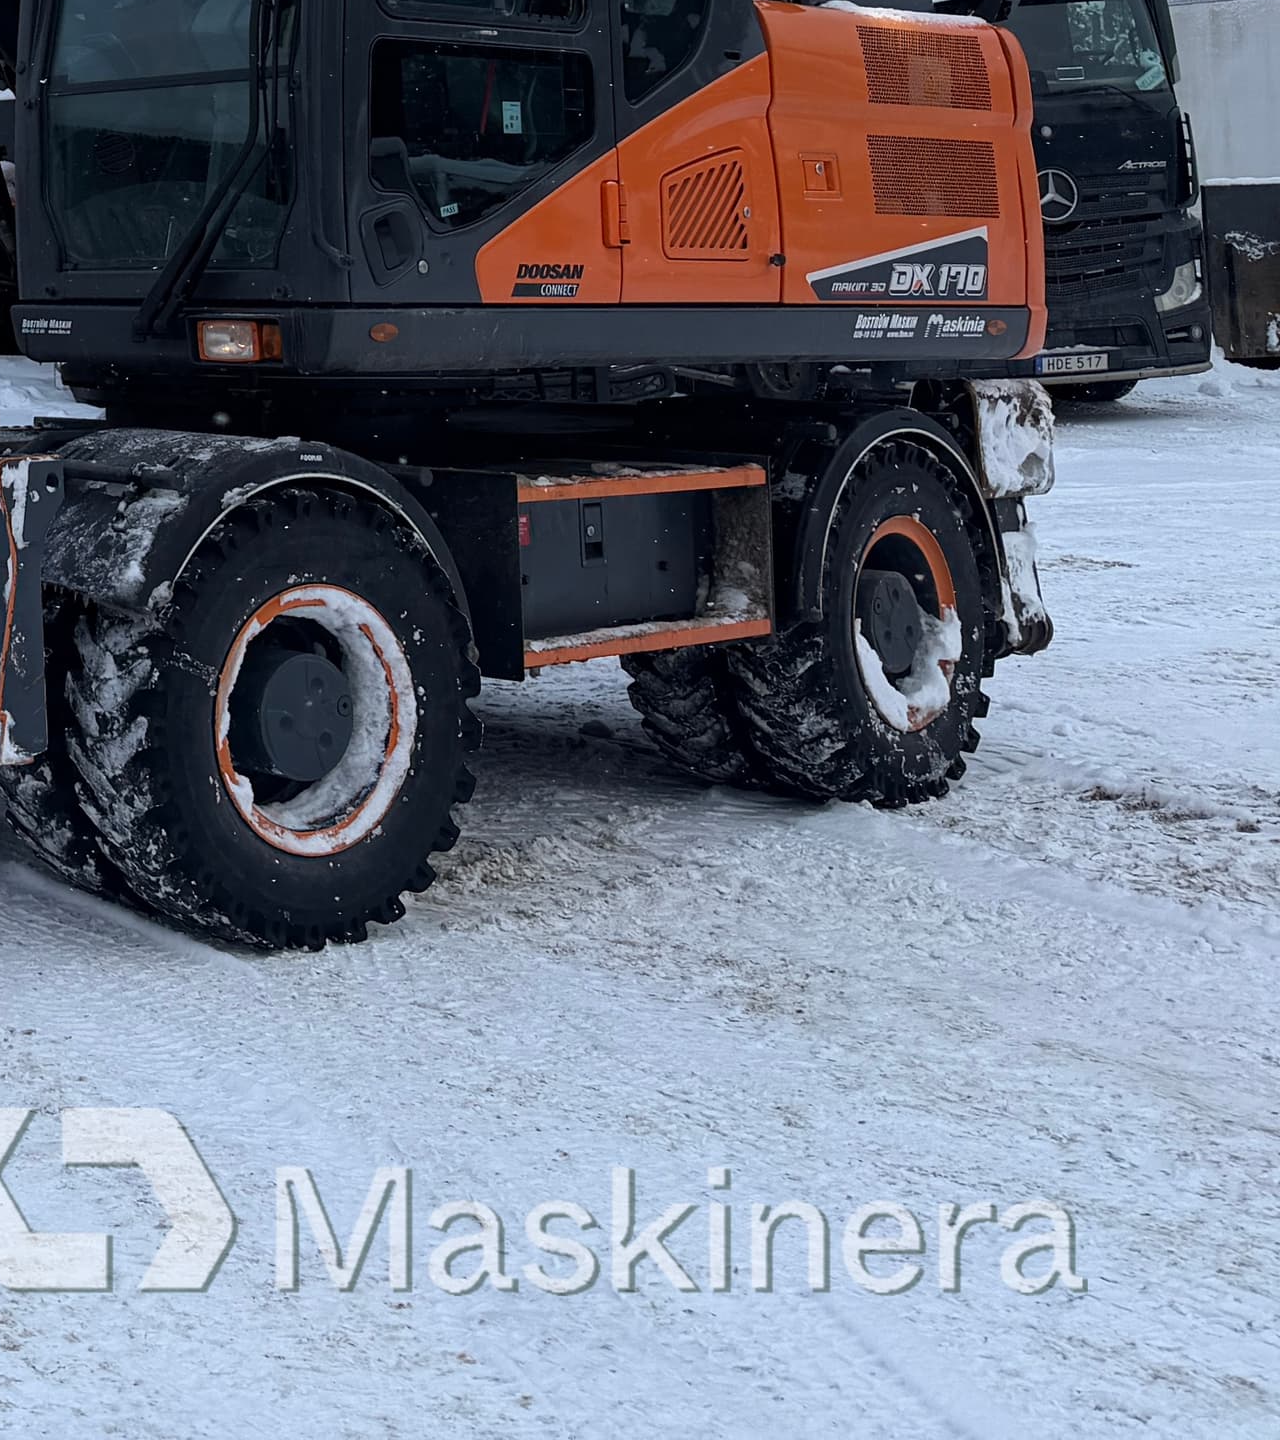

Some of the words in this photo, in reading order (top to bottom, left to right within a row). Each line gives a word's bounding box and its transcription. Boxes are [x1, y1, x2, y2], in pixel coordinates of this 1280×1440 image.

[516, 263, 584, 279] DOOSAN
[870, 282, 886, 292] 3D
[889, 263, 935, 296] DX
[938, 263, 988, 296] 170
[540, 284, 578, 296] CONNECT
[924, 314, 985, 338] Maskinia
[1047, 358, 1073, 371] HDE
[1076, 356, 1102, 369] 517
